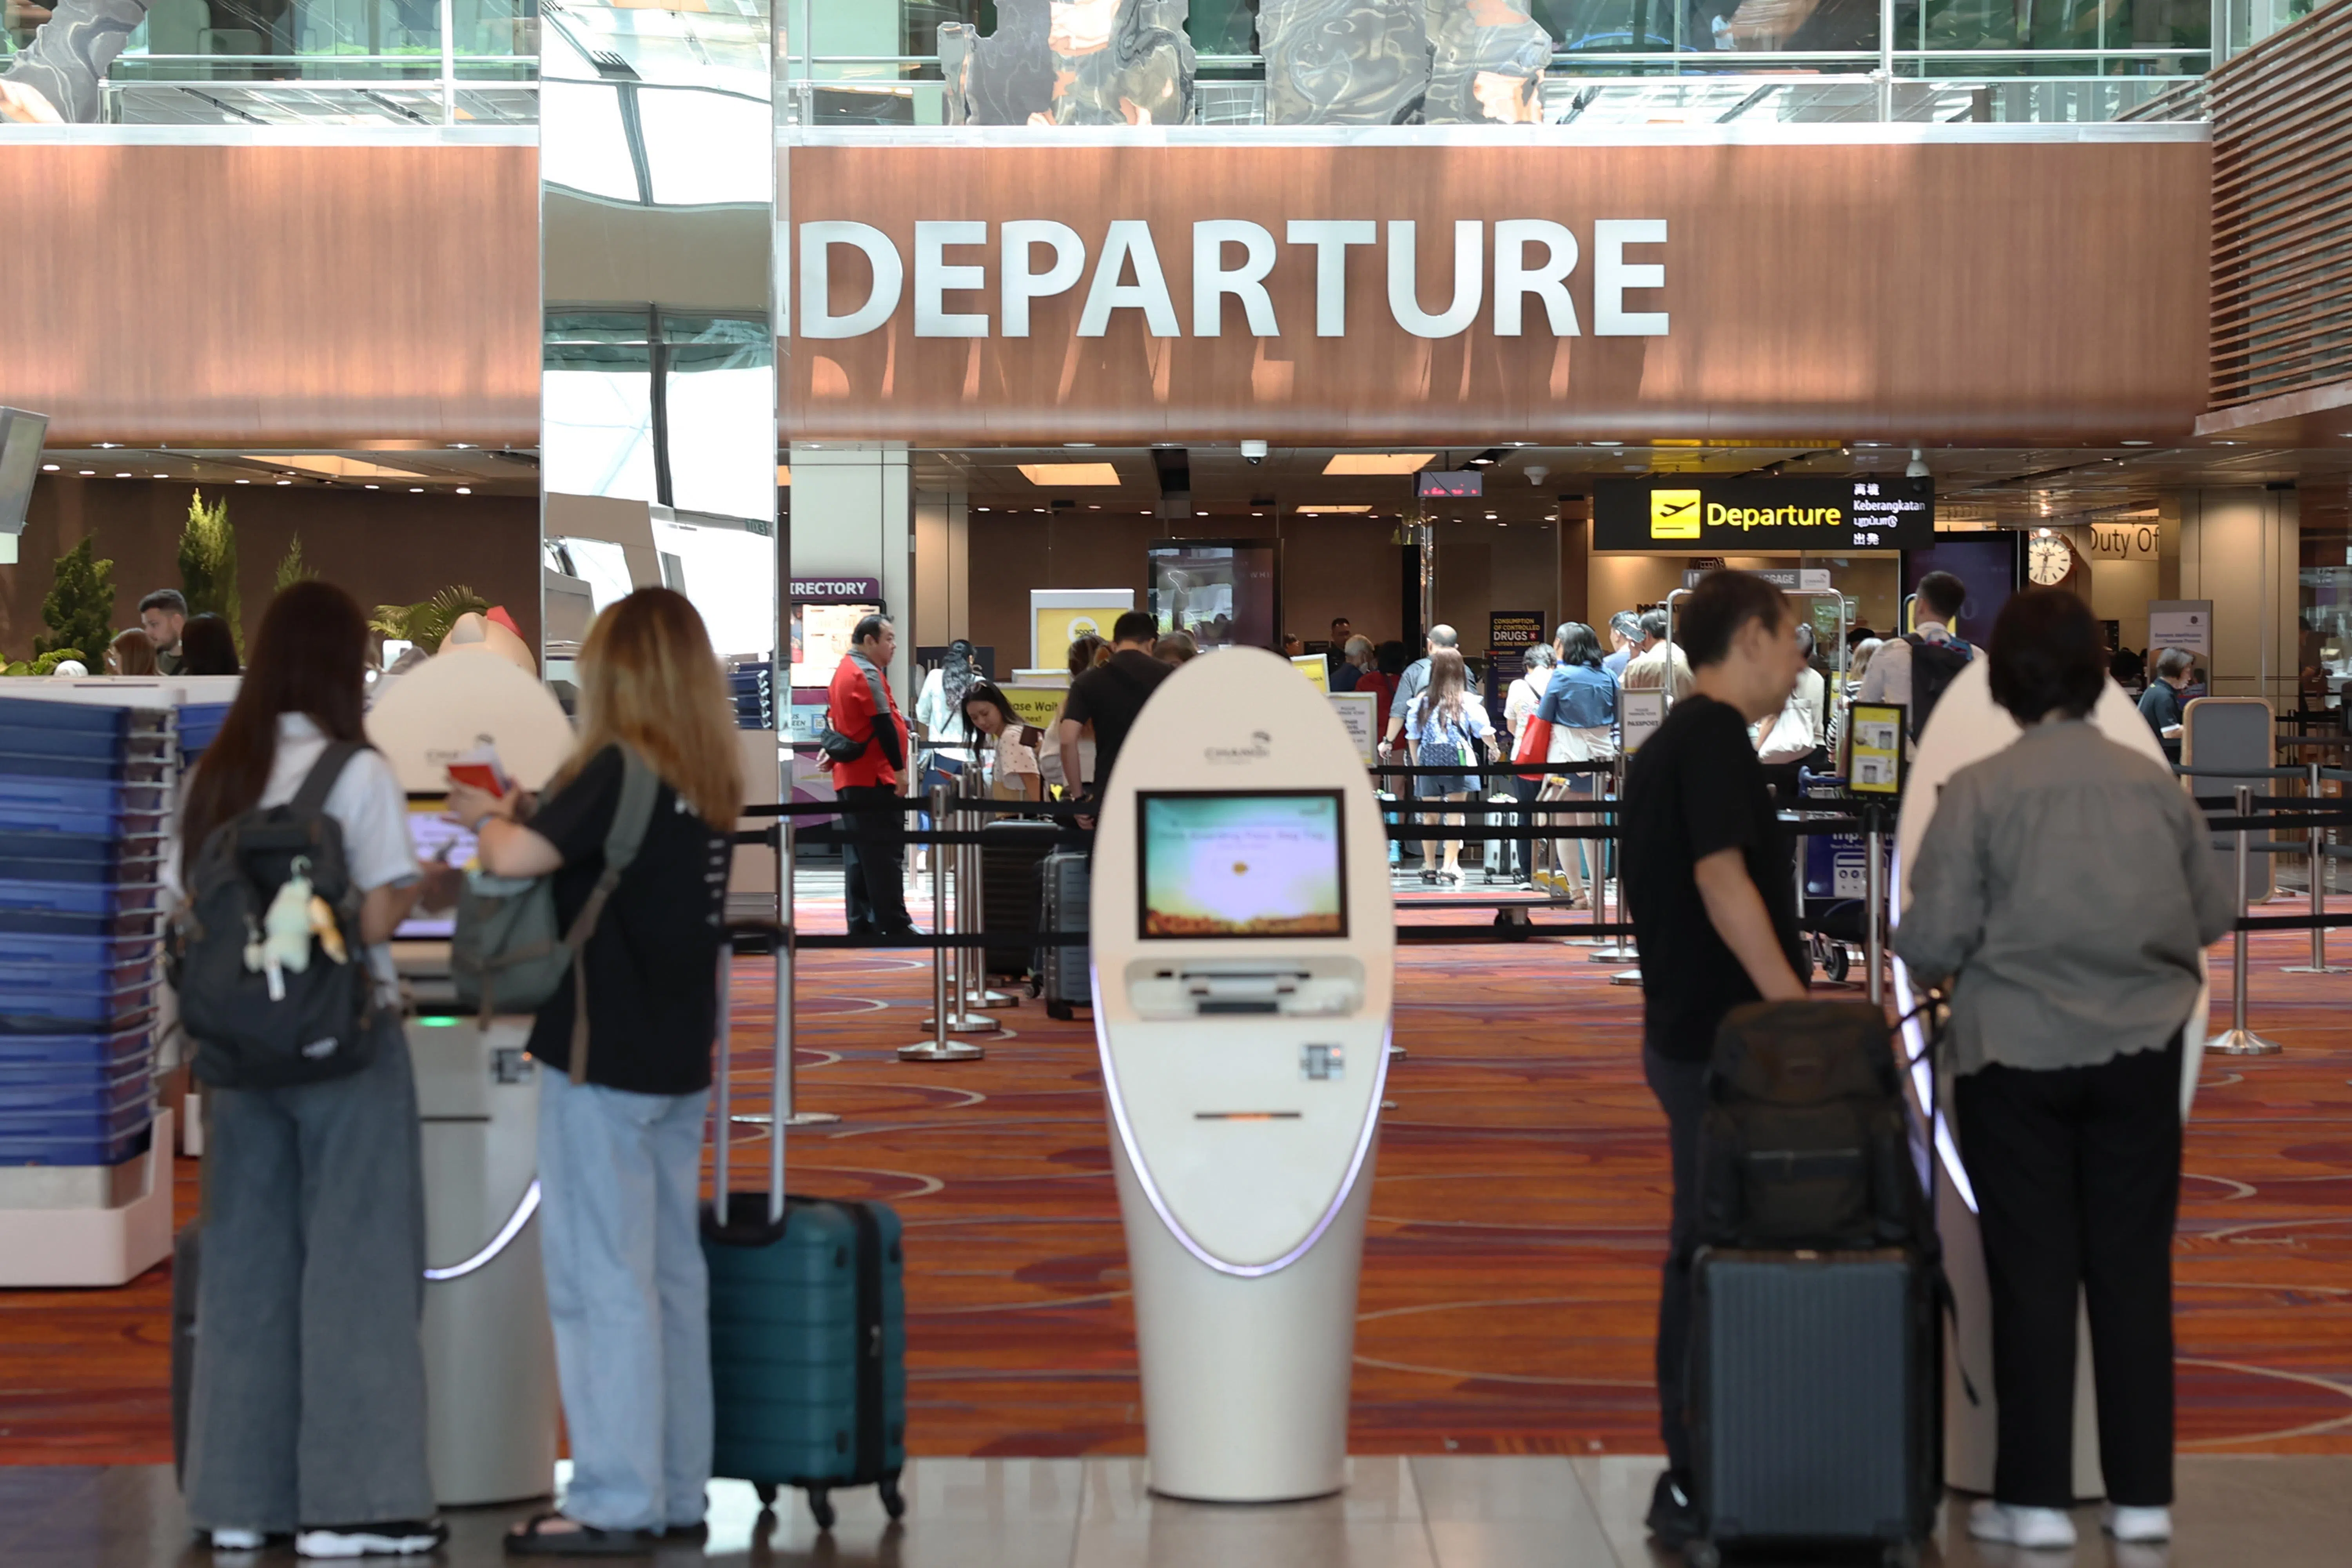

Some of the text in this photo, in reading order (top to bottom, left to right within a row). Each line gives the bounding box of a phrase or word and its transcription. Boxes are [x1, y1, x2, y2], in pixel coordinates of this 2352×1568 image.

[800, 219, 1669, 338] DEPARTURE
[1854, 483, 1880, 495] 离境
[1853, 499, 1926, 513] Keberangkatan
[1707, 503, 1841, 531] Departure
[1853, 533, 1880, 545] 出発
[1494, 631, 1528, 641] DRUGS
